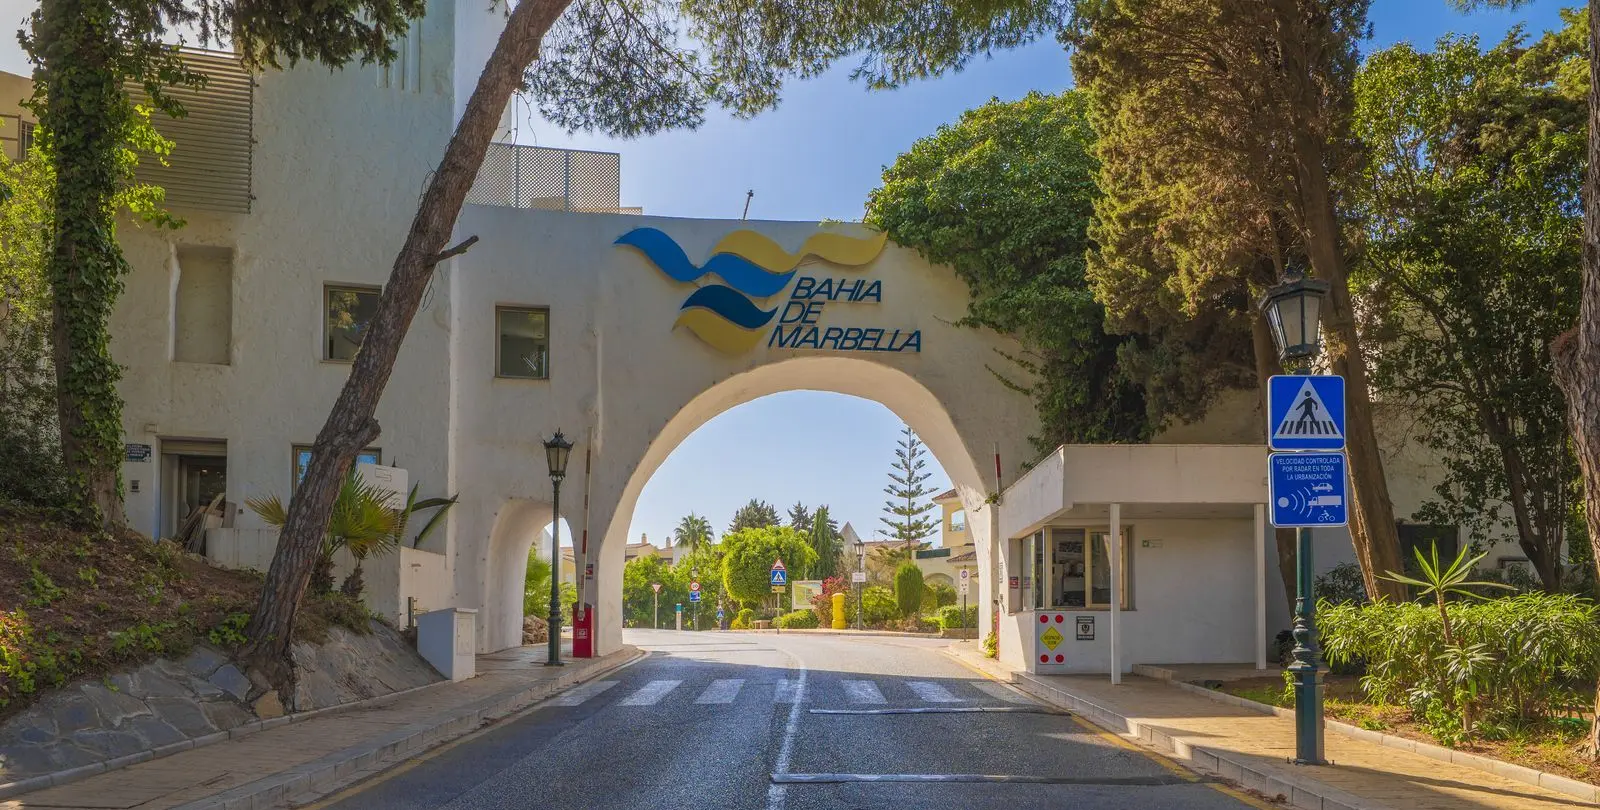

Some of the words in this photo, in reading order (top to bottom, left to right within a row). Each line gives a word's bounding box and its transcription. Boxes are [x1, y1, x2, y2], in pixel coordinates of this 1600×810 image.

[790, 277, 882, 302] BAHIA
[779, 301, 825, 324] DE
[768, 325, 922, 352] MARBELLA
